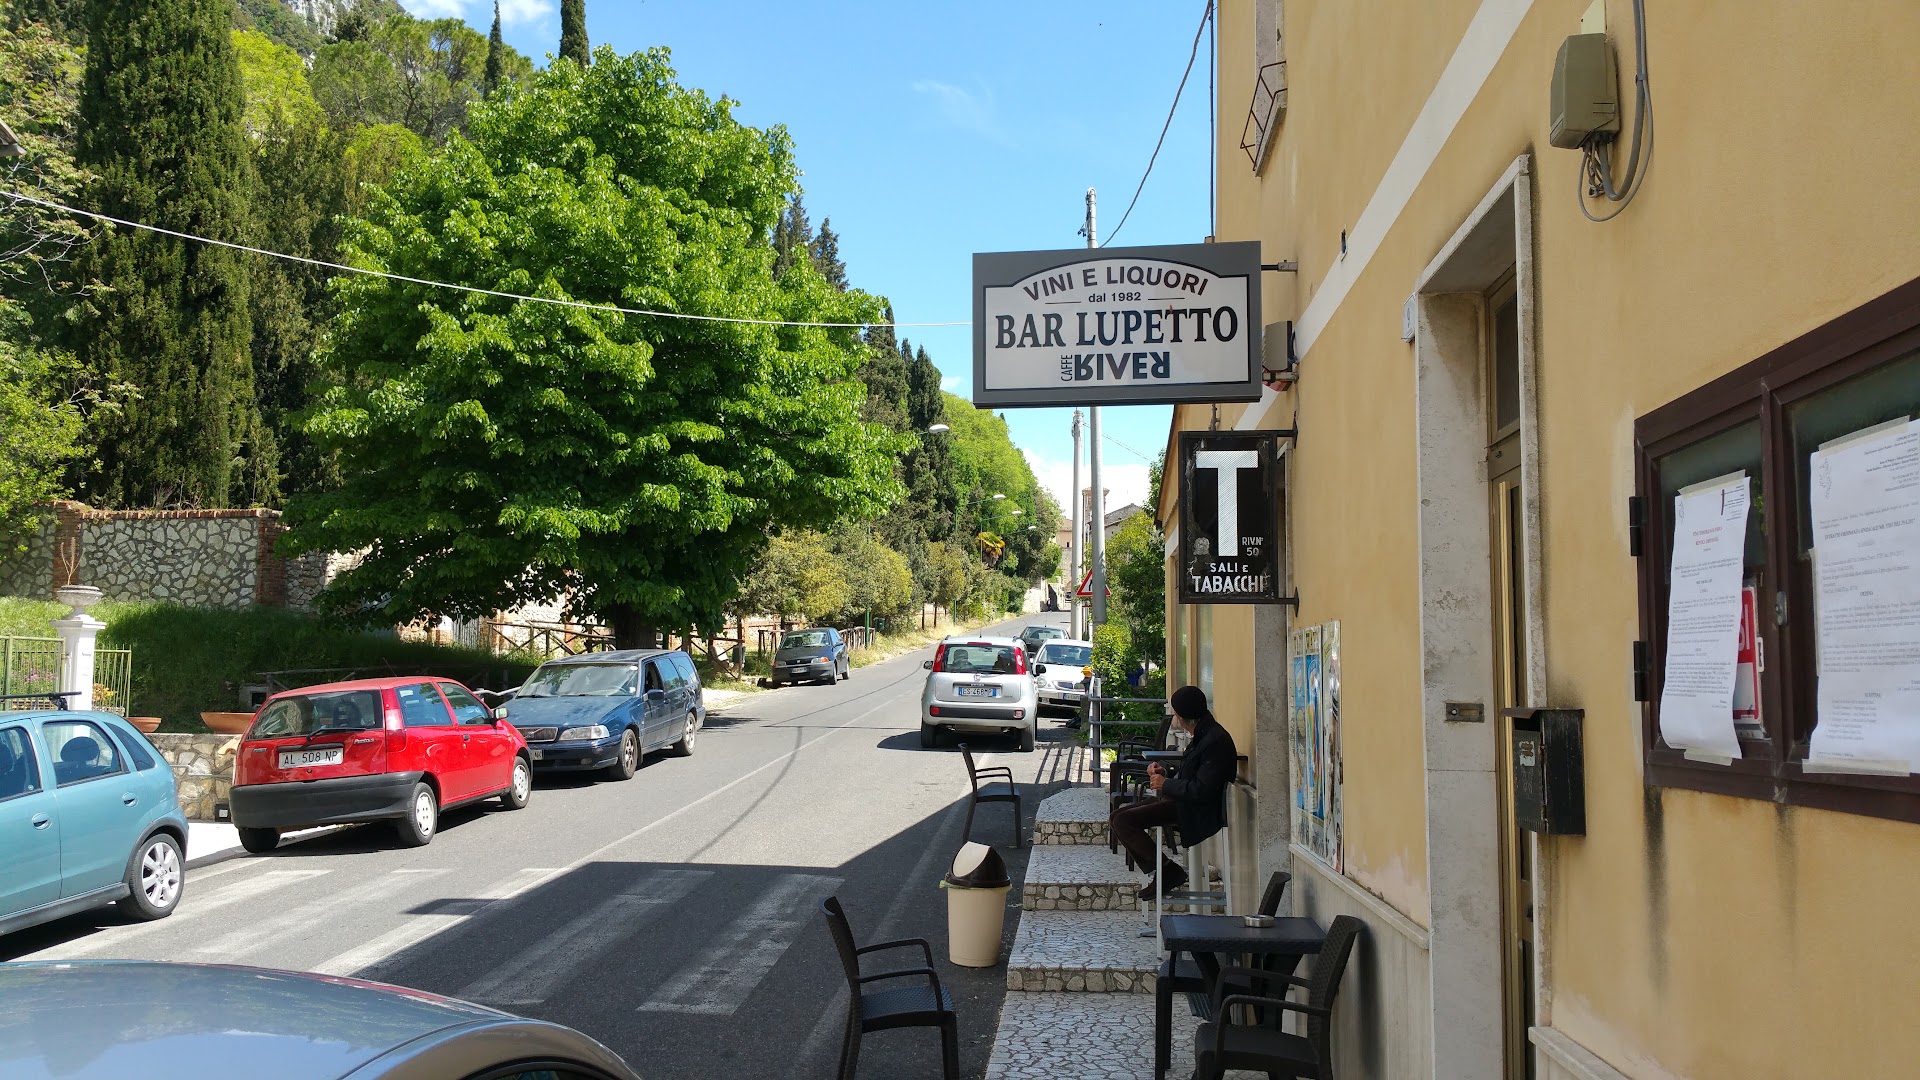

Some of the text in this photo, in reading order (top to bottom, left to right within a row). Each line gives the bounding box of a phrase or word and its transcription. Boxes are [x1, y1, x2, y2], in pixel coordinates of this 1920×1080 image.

[1023, 265, 1209, 301] VINI E LIQUORI
[1088, 291, 1141, 303] dal 1982
[995, 306, 1237, 349] BAR LUPETTO
[1060, 354, 1073, 382] CAFFE
[1196, 450, 1258, 556] T
[1246, 547, 1260, 557] 50
[1209, 562, 1249, 573] SALI E
[1192, 575, 1265, 593] TABACCHI
[283, 751, 338, 765] AL 508 NP
